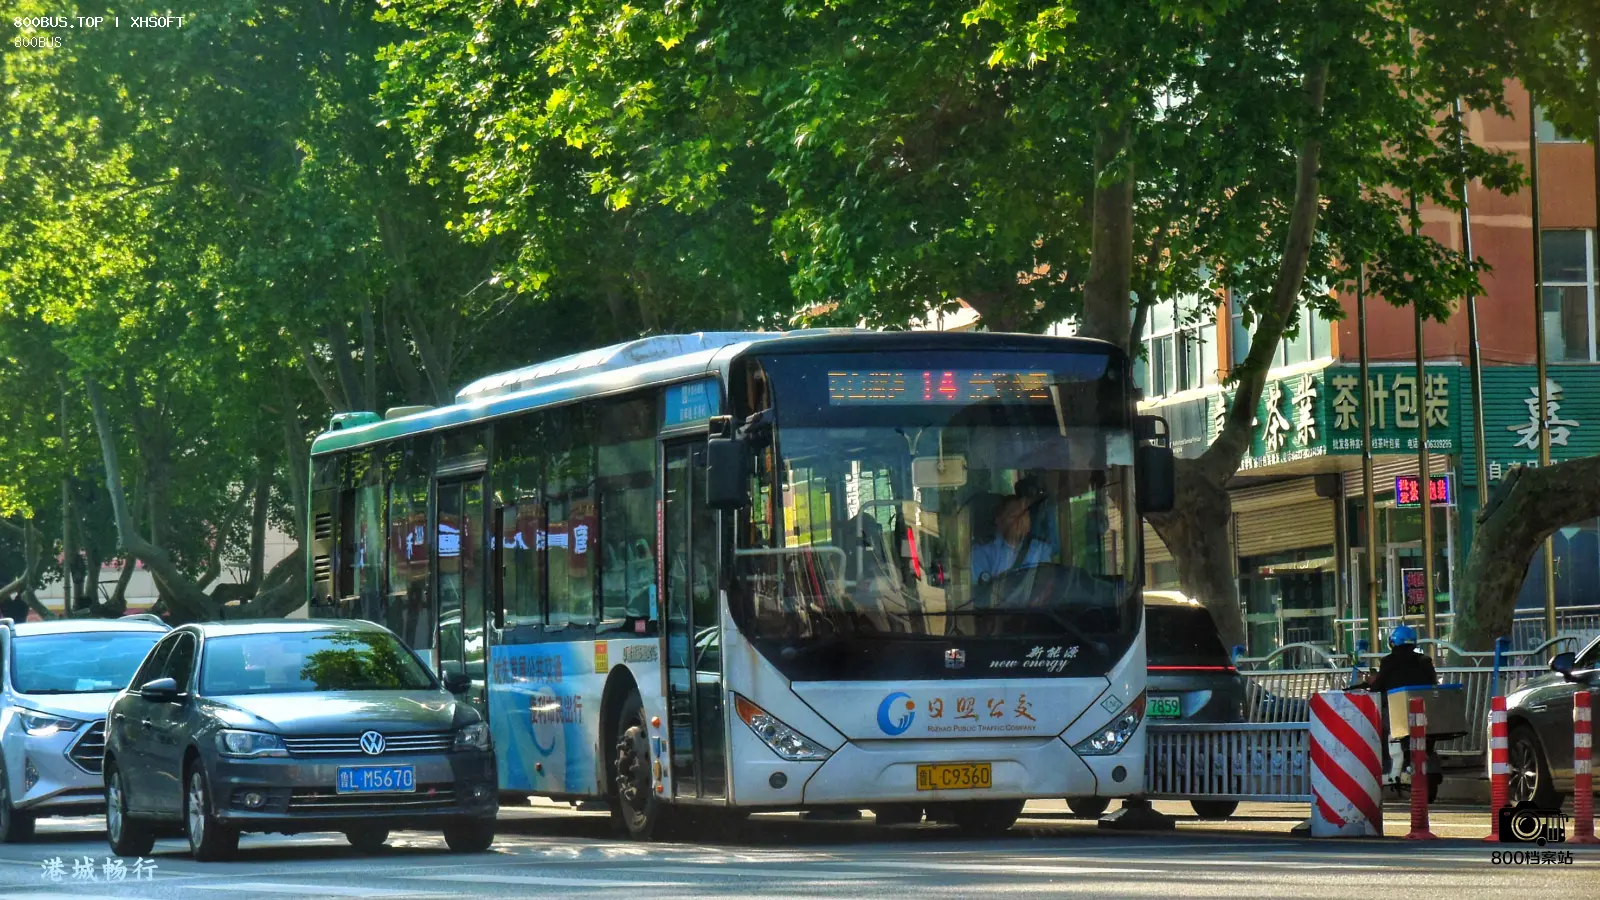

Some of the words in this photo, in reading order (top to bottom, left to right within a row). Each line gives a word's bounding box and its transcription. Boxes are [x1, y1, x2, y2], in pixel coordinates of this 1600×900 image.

[922, 371, 957, 400] 14
[1332, 373, 1449, 430] 茶叶包装
[1507, 377, 1580, 450] 嘉
[989, 660, 1018, 668] new
[1023, 659, 1069, 673] energy
[1025, 645, 1080, 659] 新能源
[928, 693, 1037, 721] 日照公交
[1150, 699, 1179, 713] 7859
